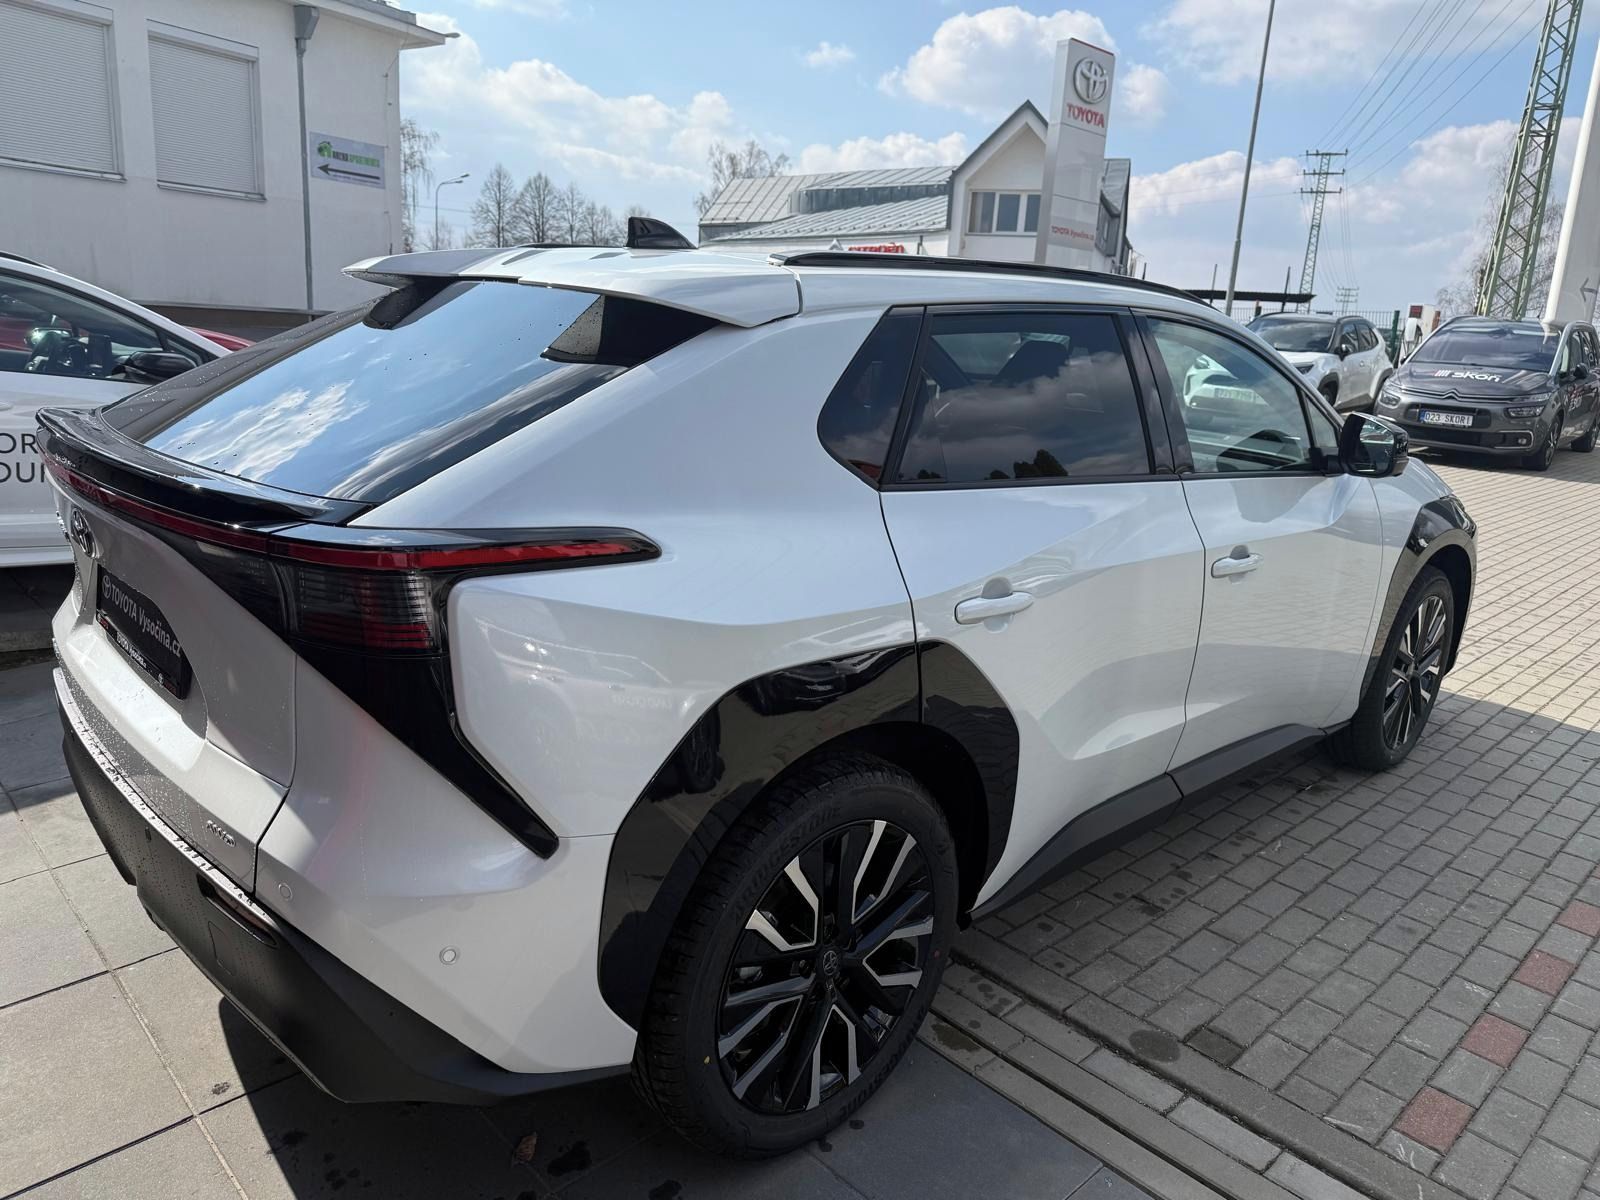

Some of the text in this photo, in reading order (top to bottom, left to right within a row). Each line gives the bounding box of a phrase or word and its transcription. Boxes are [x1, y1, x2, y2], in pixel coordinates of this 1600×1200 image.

[1067, 102, 1104, 128] TOYOTA
[111, 583, 181, 657] TOYOTA Vysočina.cz
